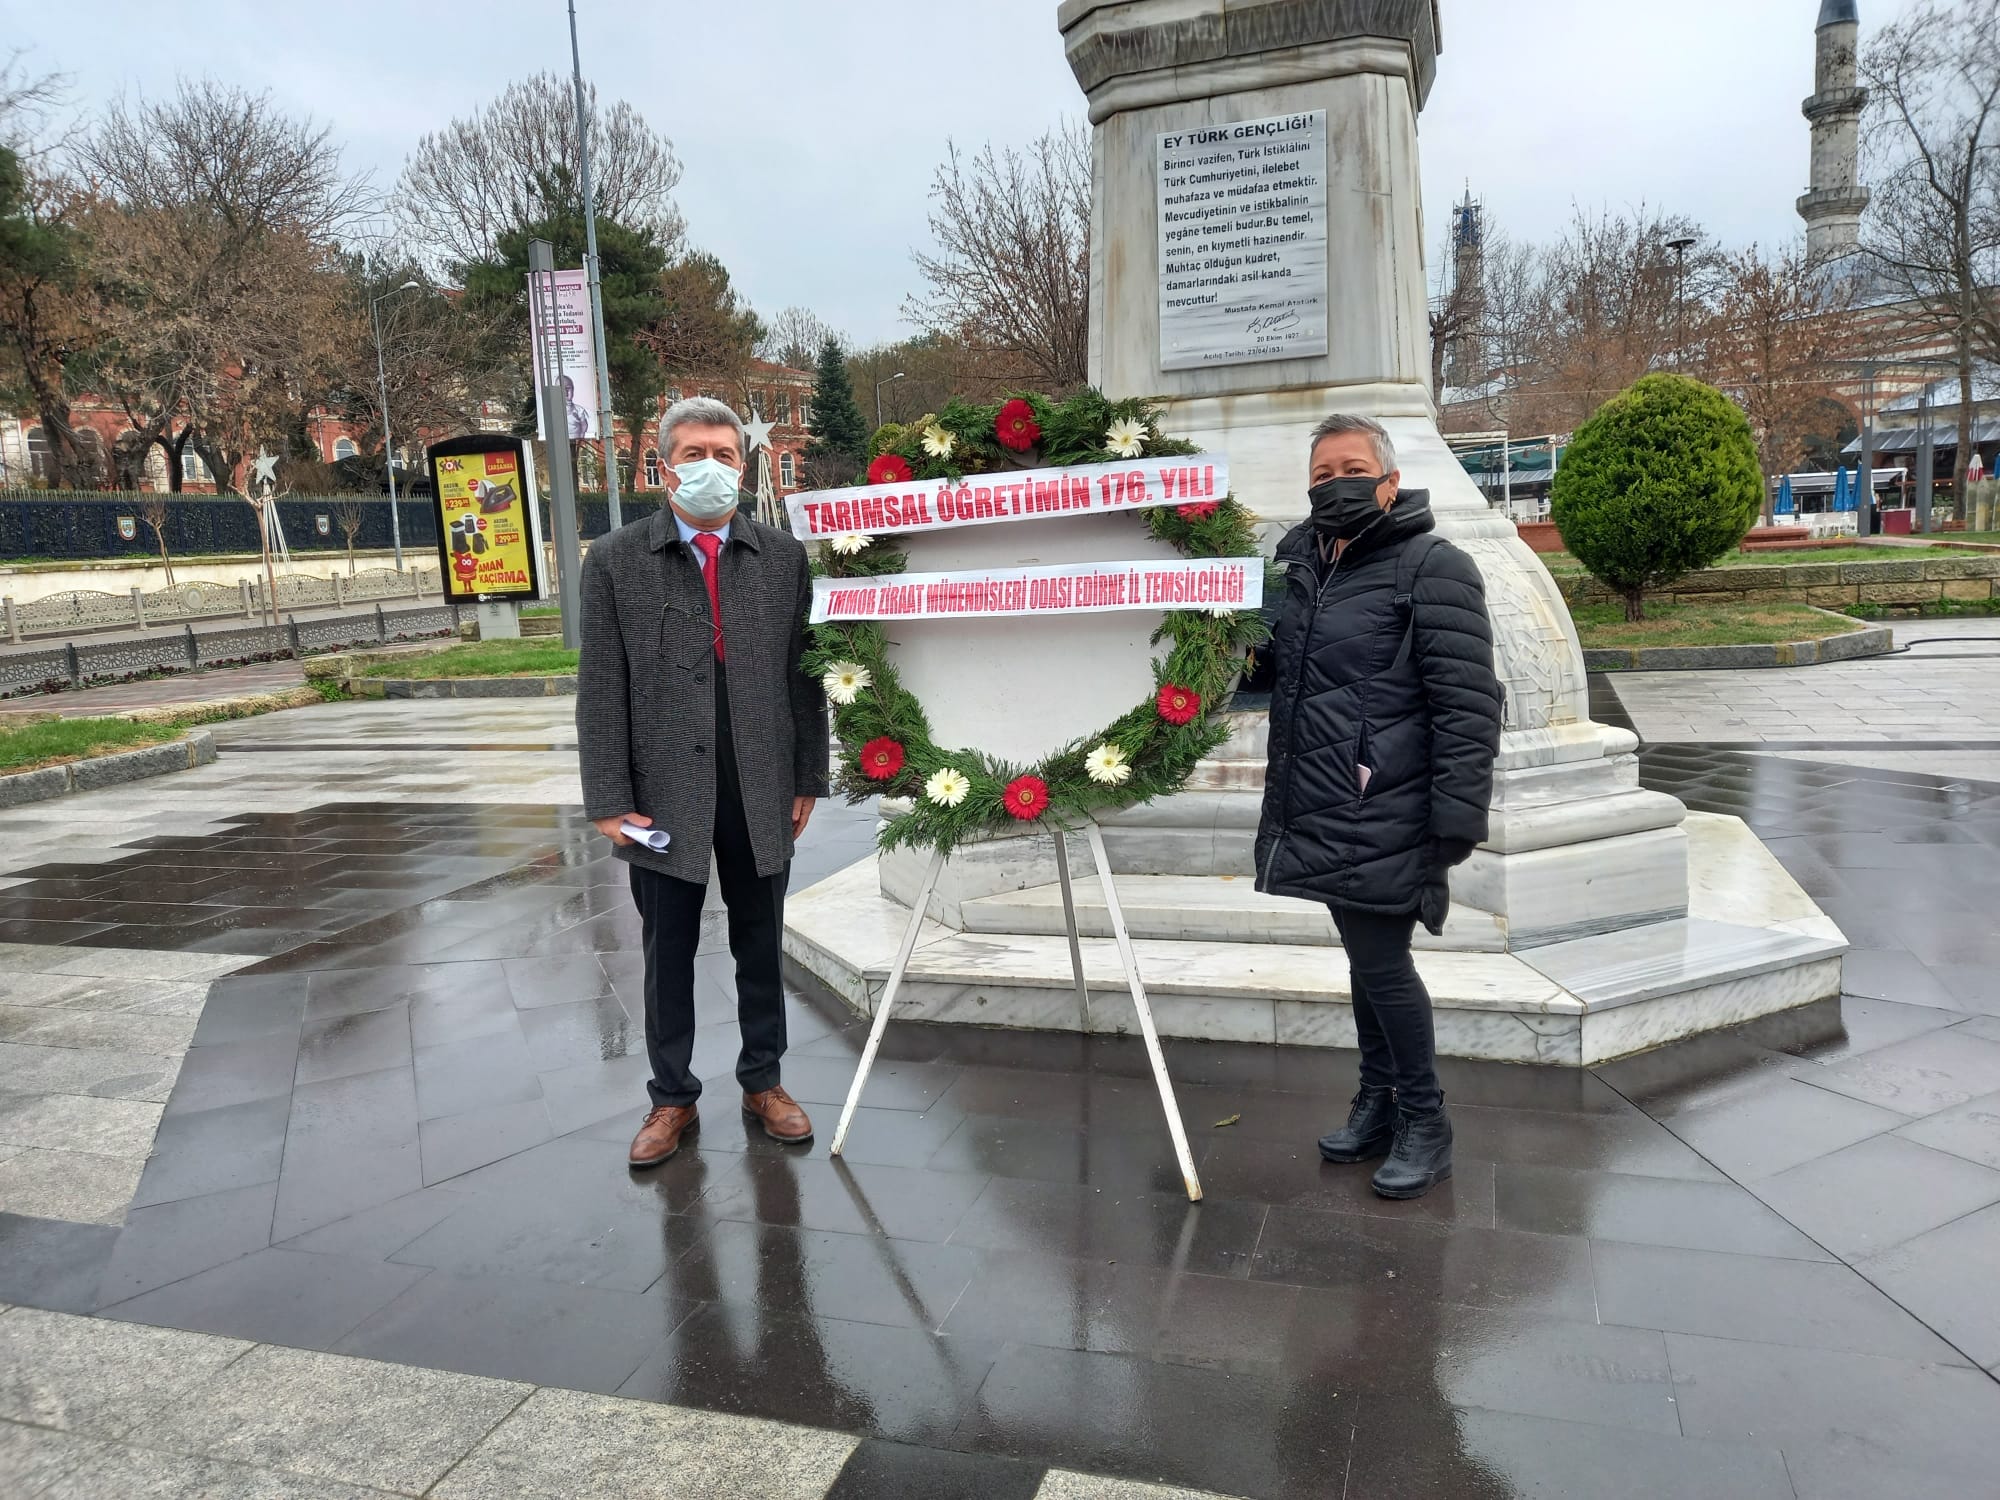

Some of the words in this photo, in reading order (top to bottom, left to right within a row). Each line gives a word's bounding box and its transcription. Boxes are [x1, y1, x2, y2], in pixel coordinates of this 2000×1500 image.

[1164, 135, 1182, 148] EY
[1188, 130, 1229, 145] TÜRK
[1164, 156, 1195, 170] Birinci
[1198, 152, 1235, 166] vazifen,
[1238, 148, 1261, 160] Türk
[1164, 175, 1186, 188] Türk
[1189, 163, 1260, 185] Cumhuriyetini,
[1262, 159, 1300, 175] ilelebet
[1165, 192, 1210, 205] muhafaza
[1213, 189, 1225, 199] ve
[1228, 183, 1270, 197] müdafaa
[1272, 175, 1318, 191] etmektir.
[1165, 204, 1237, 223] Mevcudiyetinin
[1240, 203, 1251, 213] ve
[1254, 194, 1309, 211] istikbalinin
[1166, 227, 1200, 242] yegâne
[1202, 221, 1233, 235] temeli
[1282, 210, 1314, 224] temel,
[1166, 245, 1195, 257] senin,
[1197, 243, 1209, 253] en
[1211, 236, 1250, 252] kıymetli
[1166, 260, 1201, 274] Muhtaç
[1204, 255, 1242, 270] olduğun
[1245, 252, 1280, 265] kudret,
[1166, 273, 1239, 291] damarlarındaki
[1241, 271, 1259, 282] asil
[1261, 267, 1292, 280] kanda
[1166, 292, 1218, 308] mevcuttur!
[1225, 304, 1257, 314] Mustafa
[1260, 301, 1285, 310] Kemal
[1287, 298, 1318, 307] Atatürk
[1257, 335, 1265, 343] 20
[804, 493, 933, 534] TARIMSAL
[937, 473, 1091, 522] ÖĞRETİMİN
[1097, 470, 1153, 506] 176.
[1159, 465, 1214, 499] YILI
[479, 557, 504, 573] AMAN
[479, 569, 528, 586] KAÇIRMA
[827, 589, 876, 616] TMMOB
[878, 582, 925, 615] ZİRAAT
[927, 574, 1027, 613] MÜHENDİSLERİ
[1030, 577, 1072, 609] ODASI
[1076, 570, 1125, 607] EDİRNE
[1128, 568, 1141, 604] İL
[1144, 565, 1245, 604] TEMSİLCİLİĞİ
